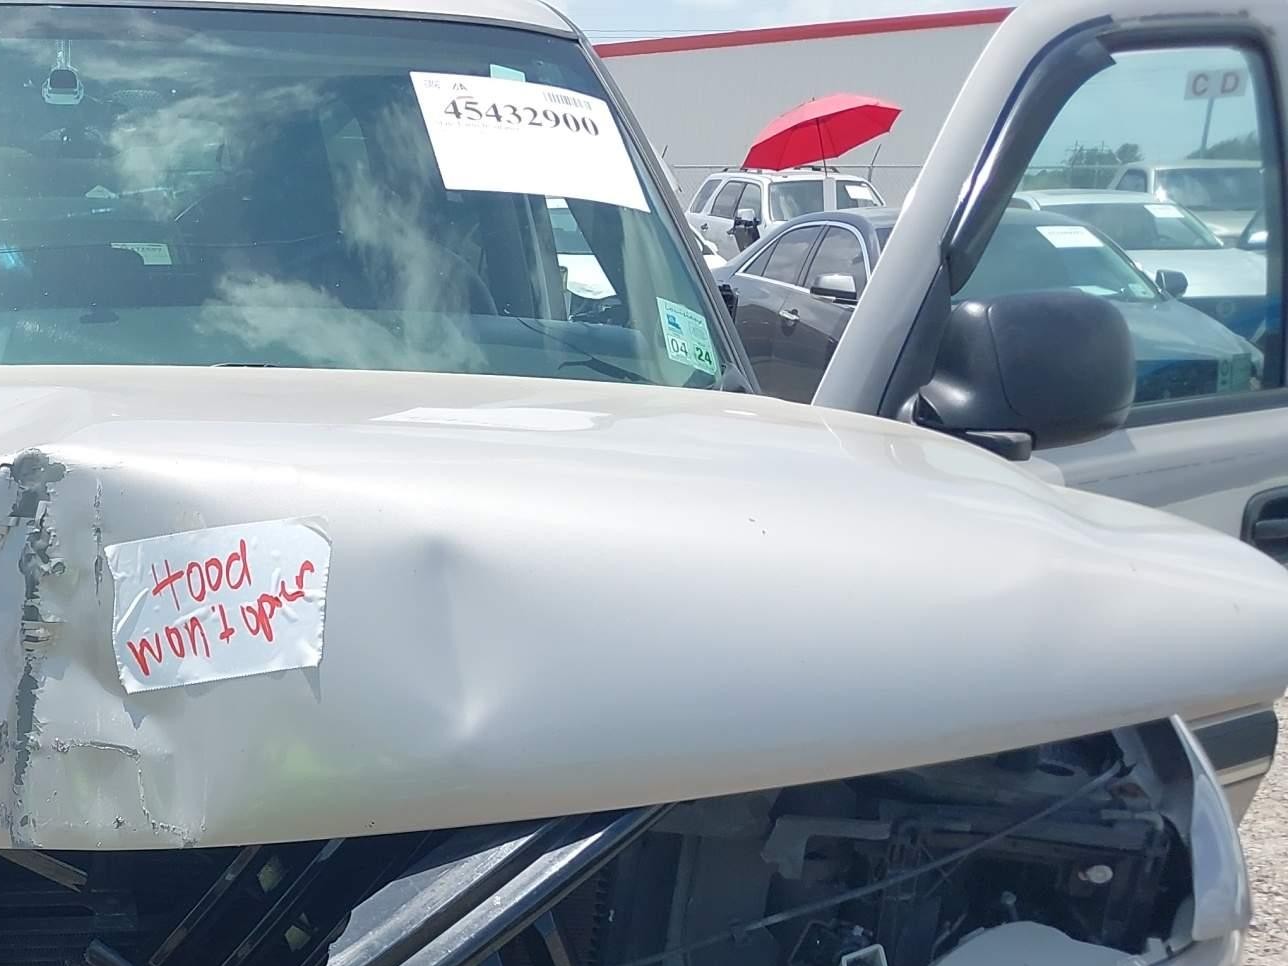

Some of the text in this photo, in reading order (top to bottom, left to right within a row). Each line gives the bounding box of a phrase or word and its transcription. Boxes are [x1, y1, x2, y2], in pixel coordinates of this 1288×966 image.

[1192, 72, 1240, 96] C D
[443, 98, 600, 137] 45432900
[671, 338, 712, 365] 04 24
[152, 539, 252, 611] Hood
